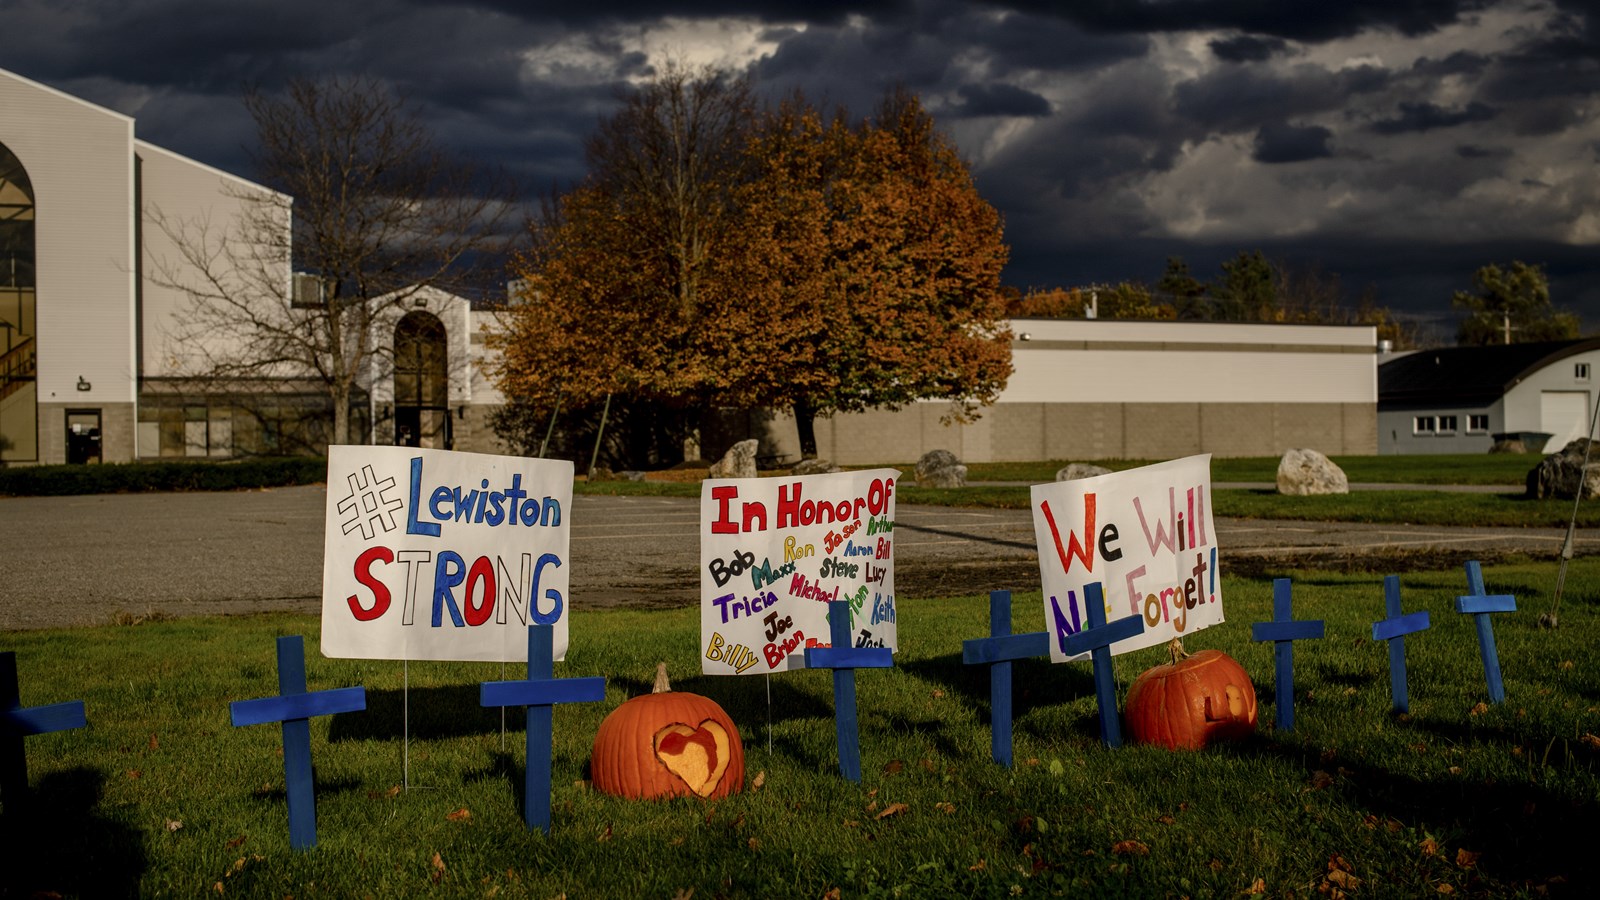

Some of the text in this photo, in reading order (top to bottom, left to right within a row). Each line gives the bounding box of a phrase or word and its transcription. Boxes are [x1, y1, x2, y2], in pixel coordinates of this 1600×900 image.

[711, 478, 894, 534] In Honor Of
[824, 520, 861, 555] Jason
[1040, 485, 1207, 574] We Will
[784, 536, 815, 563] Ron
[844, 540, 873, 557] Aaron
[876, 537, 890, 560] Bill
[709, 549, 755, 588] Bob
[751, 557, 797, 591] Maxx
[820, 556, 859, 579] Steve
[866, 562, 887, 587] Lucy
[347, 545, 564, 628] STRONG
[789, 573, 839, 603] Michael
[1126, 547, 1216, 633] Forget!
[713, 591, 779, 624] Tricia
[871, 592, 895, 625] Keith
[763, 611, 793, 642] Joe
[705, 632, 759, 674] Billy
[763, 630, 804, 670] Brian
